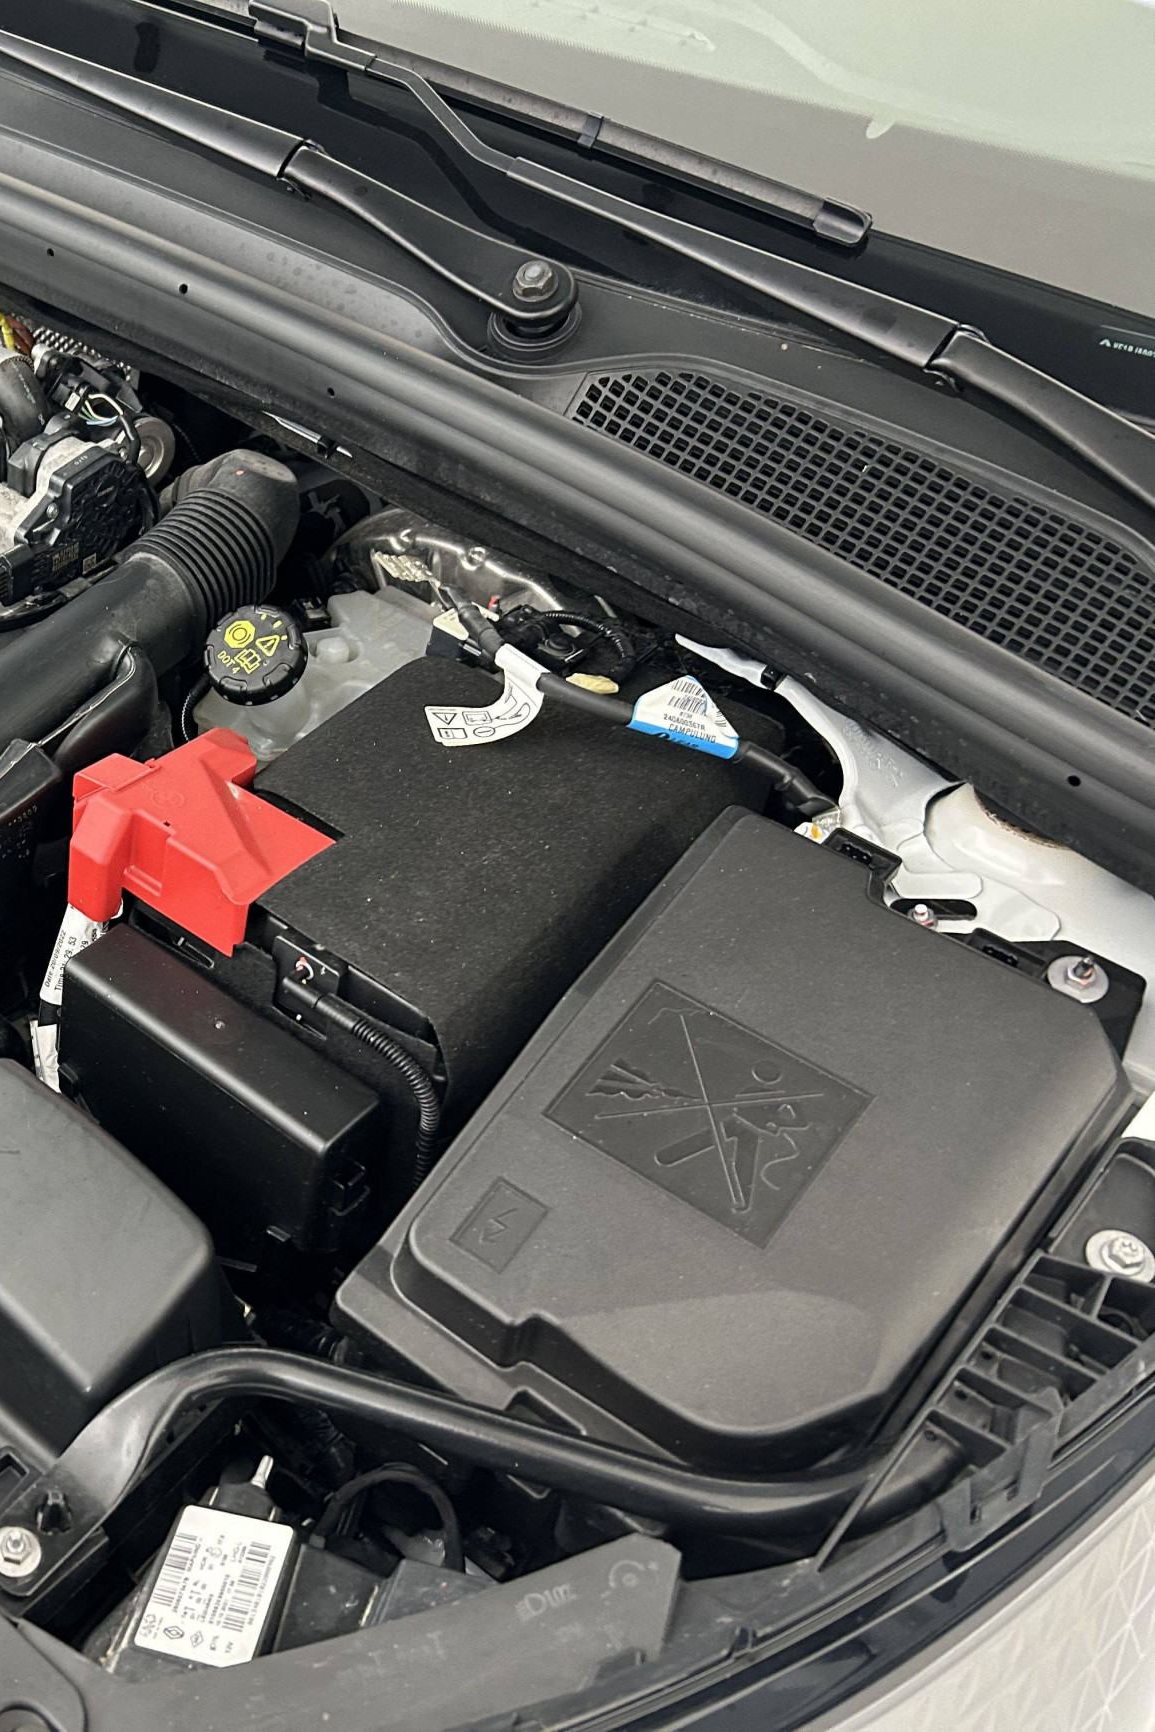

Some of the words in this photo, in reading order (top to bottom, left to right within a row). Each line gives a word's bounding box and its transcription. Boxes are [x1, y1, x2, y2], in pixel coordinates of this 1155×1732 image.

[217, 650, 236, 668] DOT
[231, 666, 241, 675] 4
[668, 723, 717, 744] CAMPULUNG
